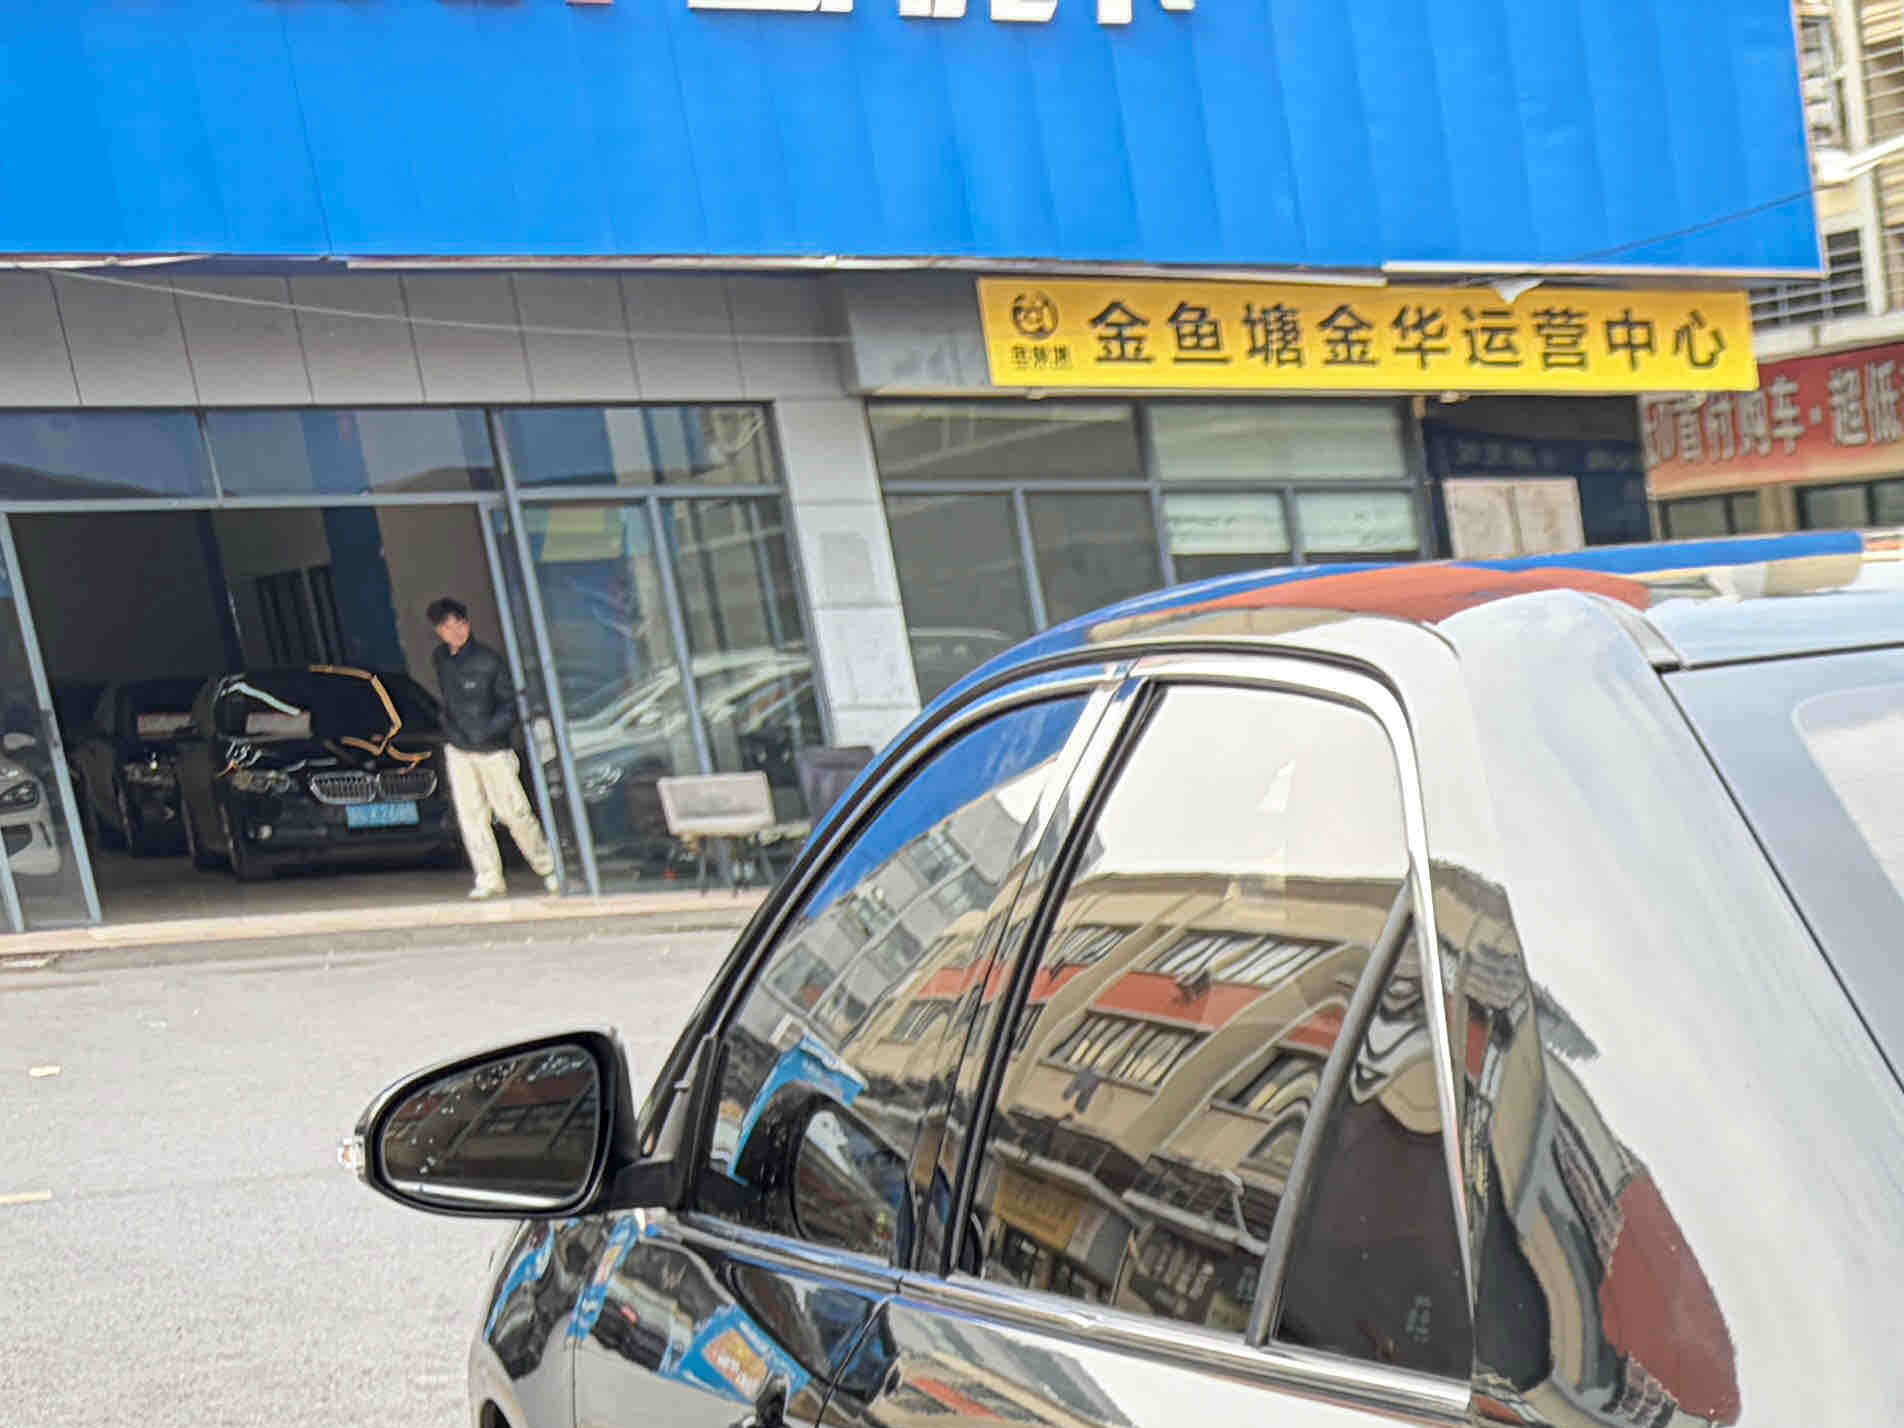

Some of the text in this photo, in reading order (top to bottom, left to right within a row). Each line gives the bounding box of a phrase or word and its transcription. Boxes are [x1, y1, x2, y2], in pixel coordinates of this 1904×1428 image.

[1089, 300, 1727, 371] 金鱼塘金华运营中心
